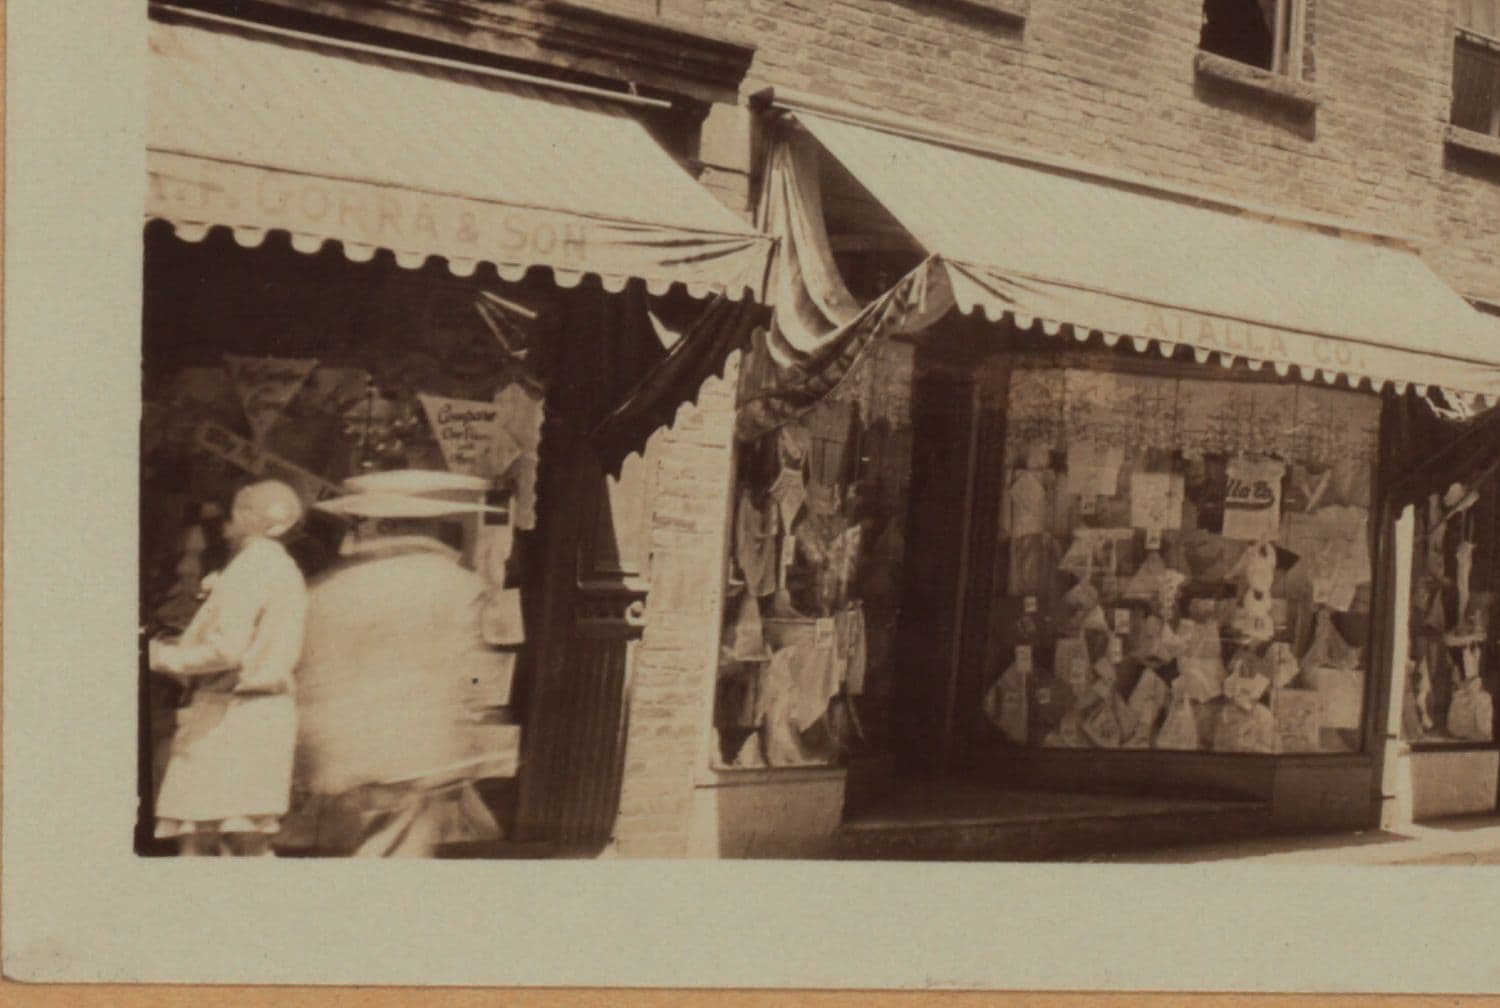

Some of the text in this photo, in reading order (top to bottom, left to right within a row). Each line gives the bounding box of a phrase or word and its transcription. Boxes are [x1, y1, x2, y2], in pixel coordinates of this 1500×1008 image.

[456, 210, 480, 245] &
[500, 217, 589, 261] SON
[1144, 307, 1367, 370] ATALLA CO.
